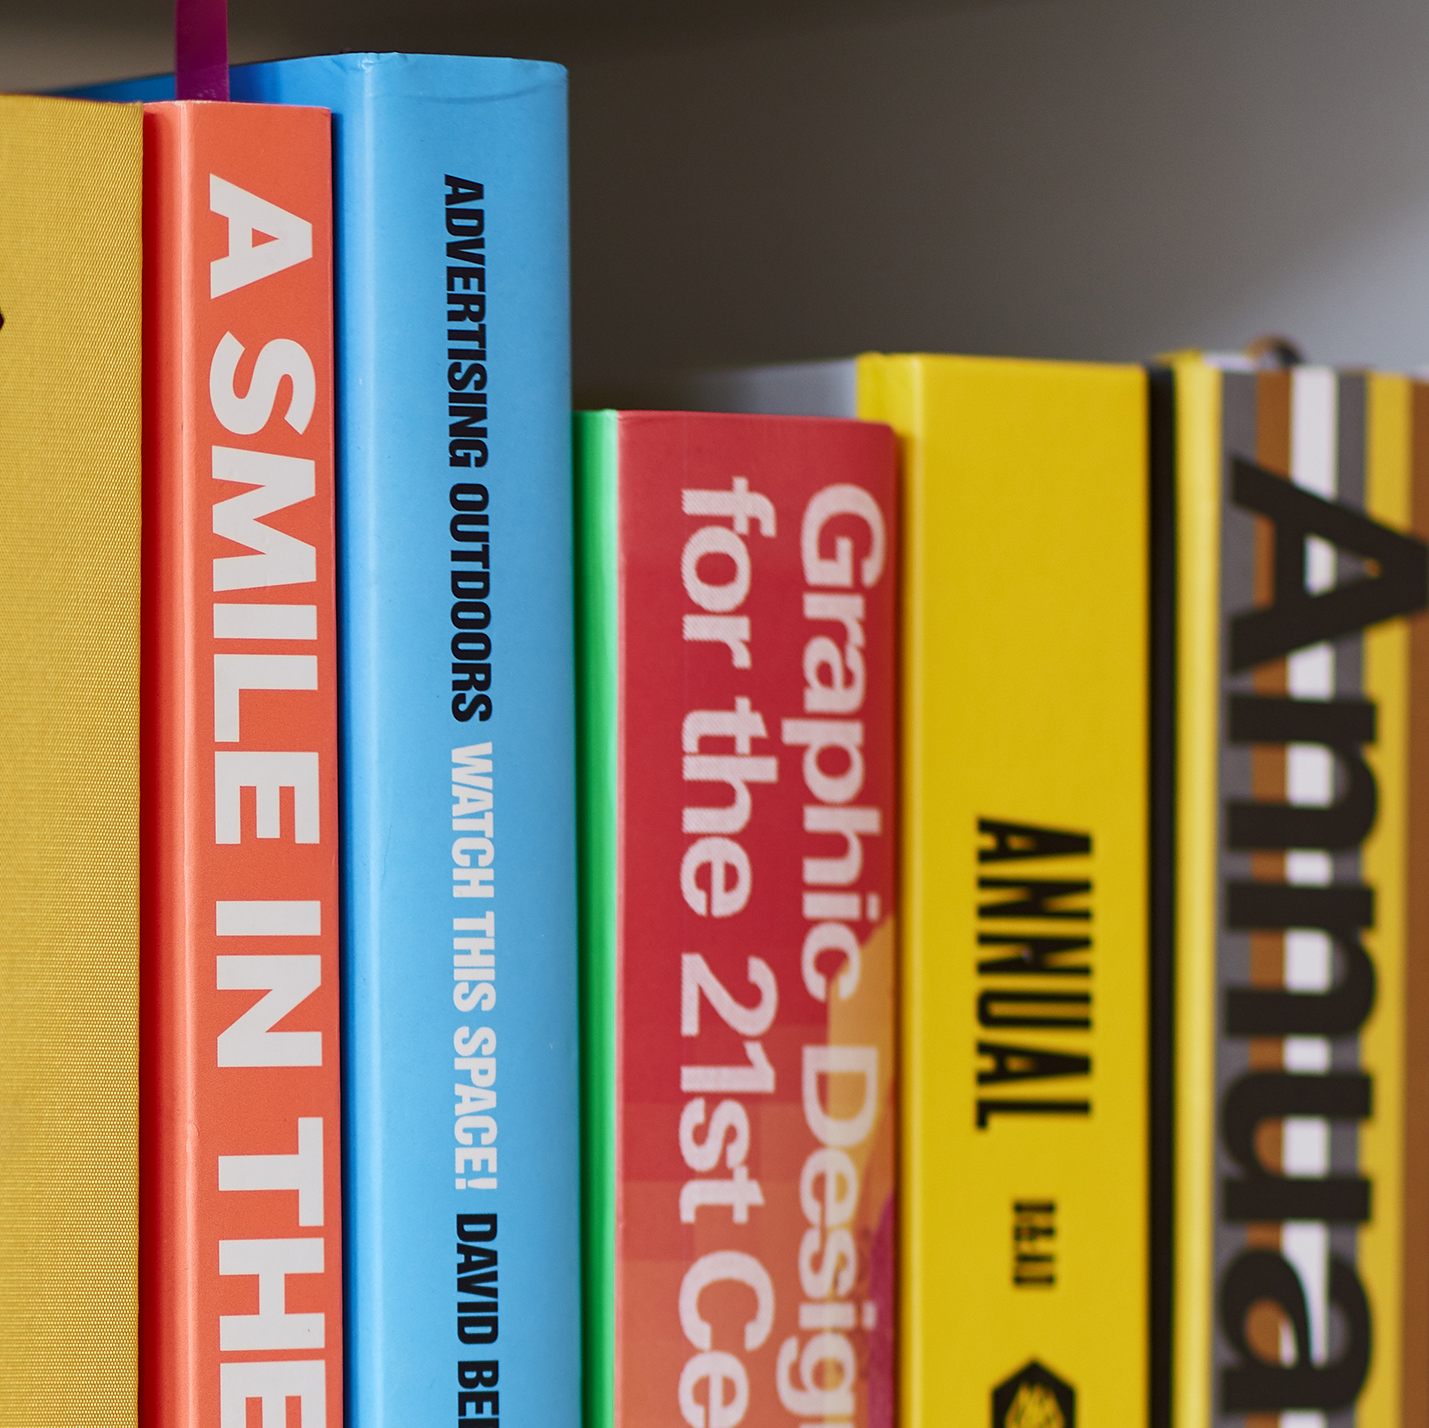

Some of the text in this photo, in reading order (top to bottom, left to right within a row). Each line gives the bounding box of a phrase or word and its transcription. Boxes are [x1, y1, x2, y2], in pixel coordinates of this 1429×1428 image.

[209, 172, 313, 299] A
[445, 174, 488, 467] ADVERTISING
[209, 331, 320, 845] SMILE
[450, 483, 492, 722] OUTDOORS
[681, 476, 776, 669] for
[452, 742, 494, 897] WATCH
[680, 696, 778, 918] the
[781, 483, 885, 1001] Graphic
[216, 901, 322, 1067] IN
[453, 911, 496, 1012] THIS
[977, 818, 1093, 1130] ANNUAL
[454, 1026, 497, 1189] SPACE!
[678, 952, 778, 1225] 21st
[457, 1214, 498, 1344] DAVID
